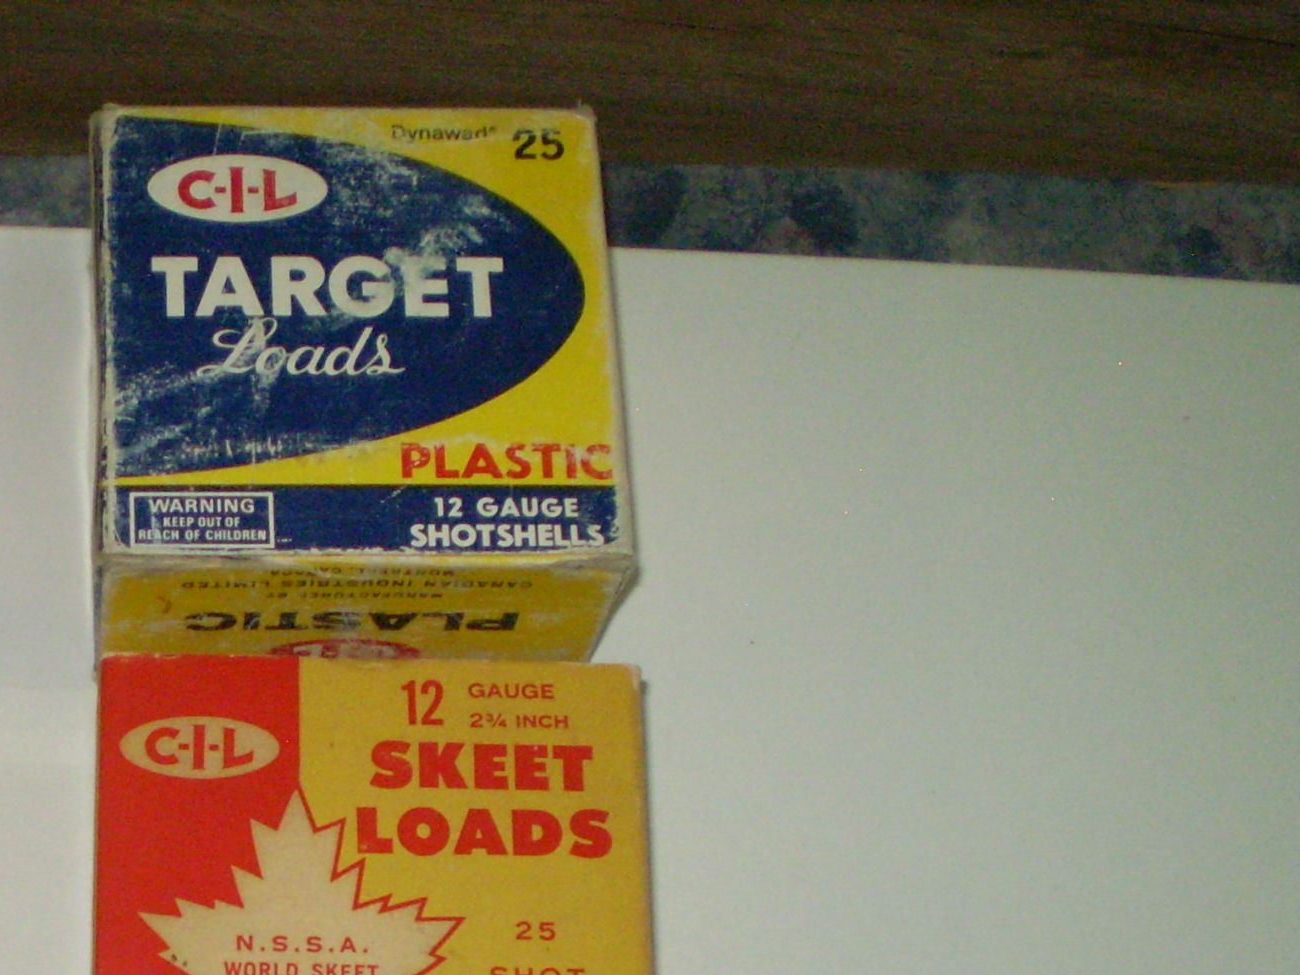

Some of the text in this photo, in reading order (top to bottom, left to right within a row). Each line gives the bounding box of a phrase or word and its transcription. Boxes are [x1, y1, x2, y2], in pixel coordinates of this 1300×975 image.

[512, 128, 564, 160] 25
[178, 167, 298, 213] C-I-L
[151, 255, 503, 318] TARGET
[198, 316, 405, 376] Loads
[401, 443, 613, 480] PLASTIC
[149, 499, 255, 513] WARNING
[434, 497, 579, 517] 12 GAUGE
[138, 529, 266, 541] REACH OF CHILDREN
[163, 516, 240, 528] KEEP OUT OF
[410, 523, 604, 547] SHOTSHELLS
[183, 612, 519, 632] PLASTIC
[401, 681, 555, 726] 12 GAUGE
[516, 715, 569, 730] INCH
[144, 724, 254, 770] C-I-L
[369, 740, 594, 792] SKEET
[356, 807, 613, 859] LOADS
[236, 934, 369, 954] N.S.S.A.
[515, 921, 557, 941] 25
